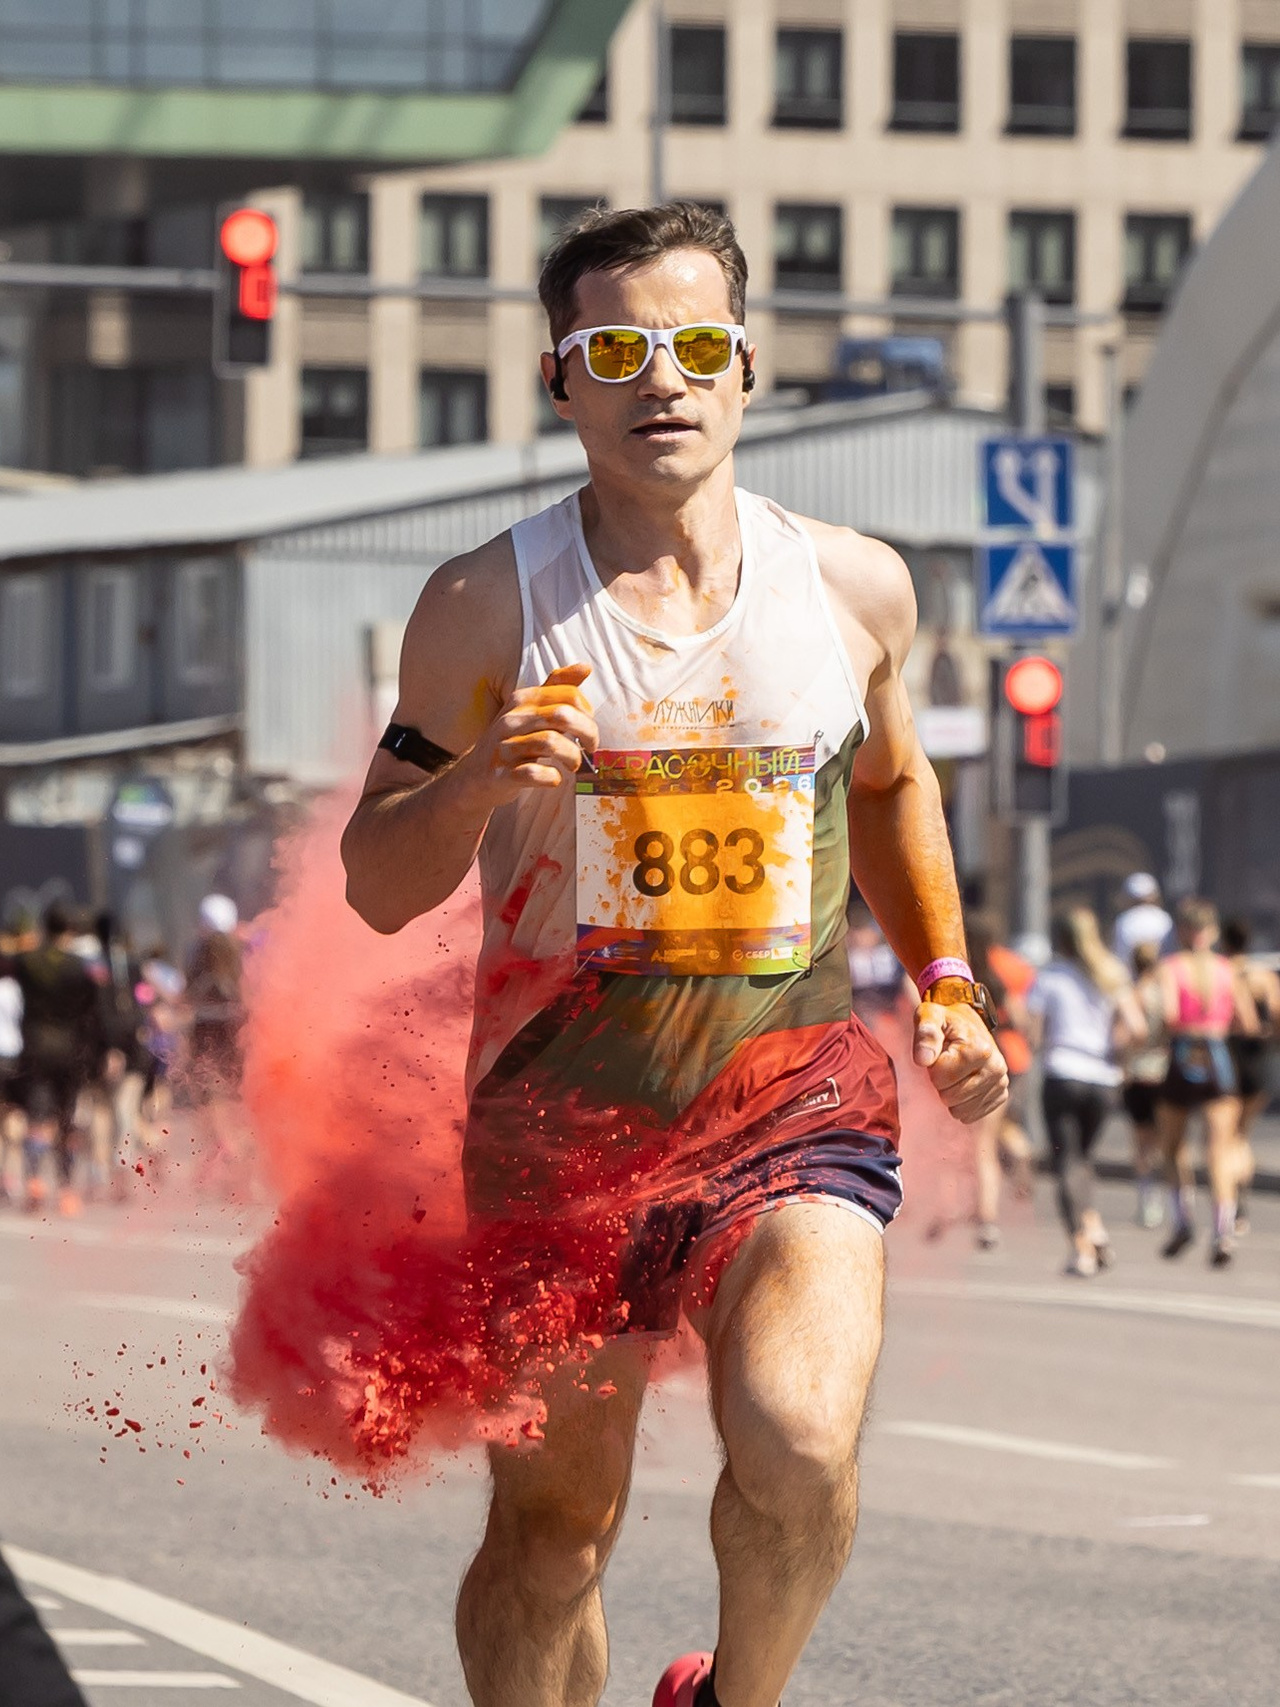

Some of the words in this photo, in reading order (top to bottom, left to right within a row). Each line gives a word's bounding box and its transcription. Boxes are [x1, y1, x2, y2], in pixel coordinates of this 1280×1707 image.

[596, 749, 801, 780] КРАСОЧНЫЙ
[715, 775, 812, 794] 2026
[632, 827, 766, 898] 883
